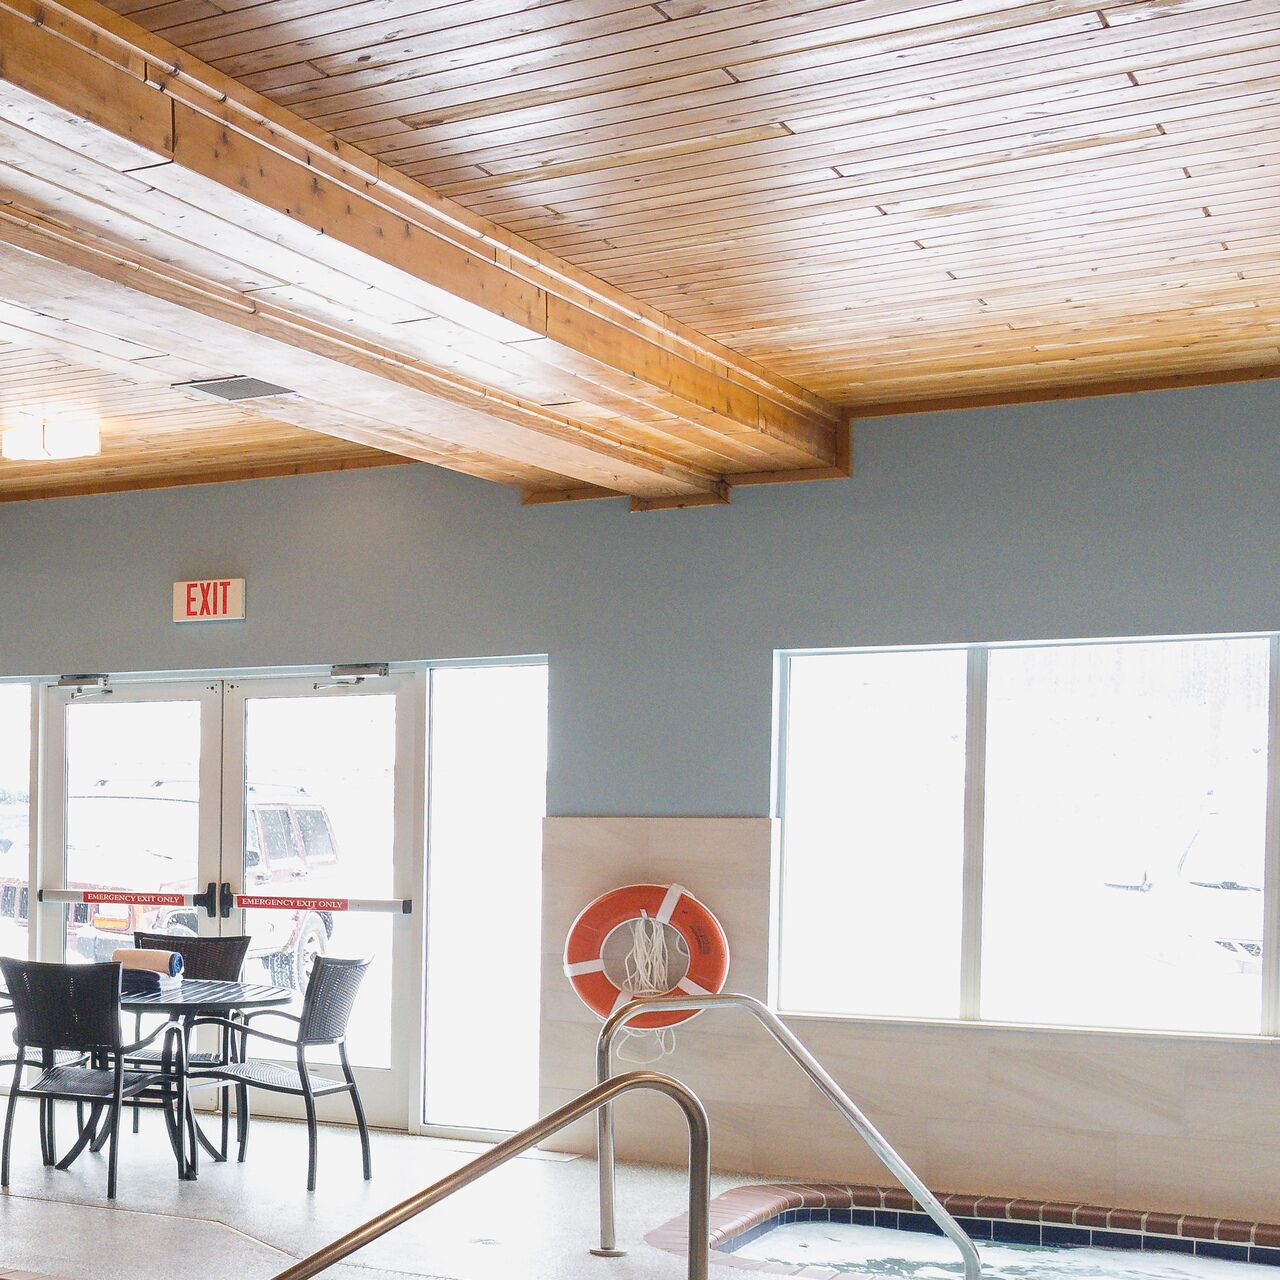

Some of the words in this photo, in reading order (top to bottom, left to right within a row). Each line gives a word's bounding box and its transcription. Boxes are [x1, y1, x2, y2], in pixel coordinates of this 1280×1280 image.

[186, 581, 231, 617] EXIT
[87, 893, 136, 902] EMERGENCY
[242, 898, 295, 906] EMERGENCY
[296, 899, 318, 907] EXIT
[318, 900, 344, 908] ONLY
